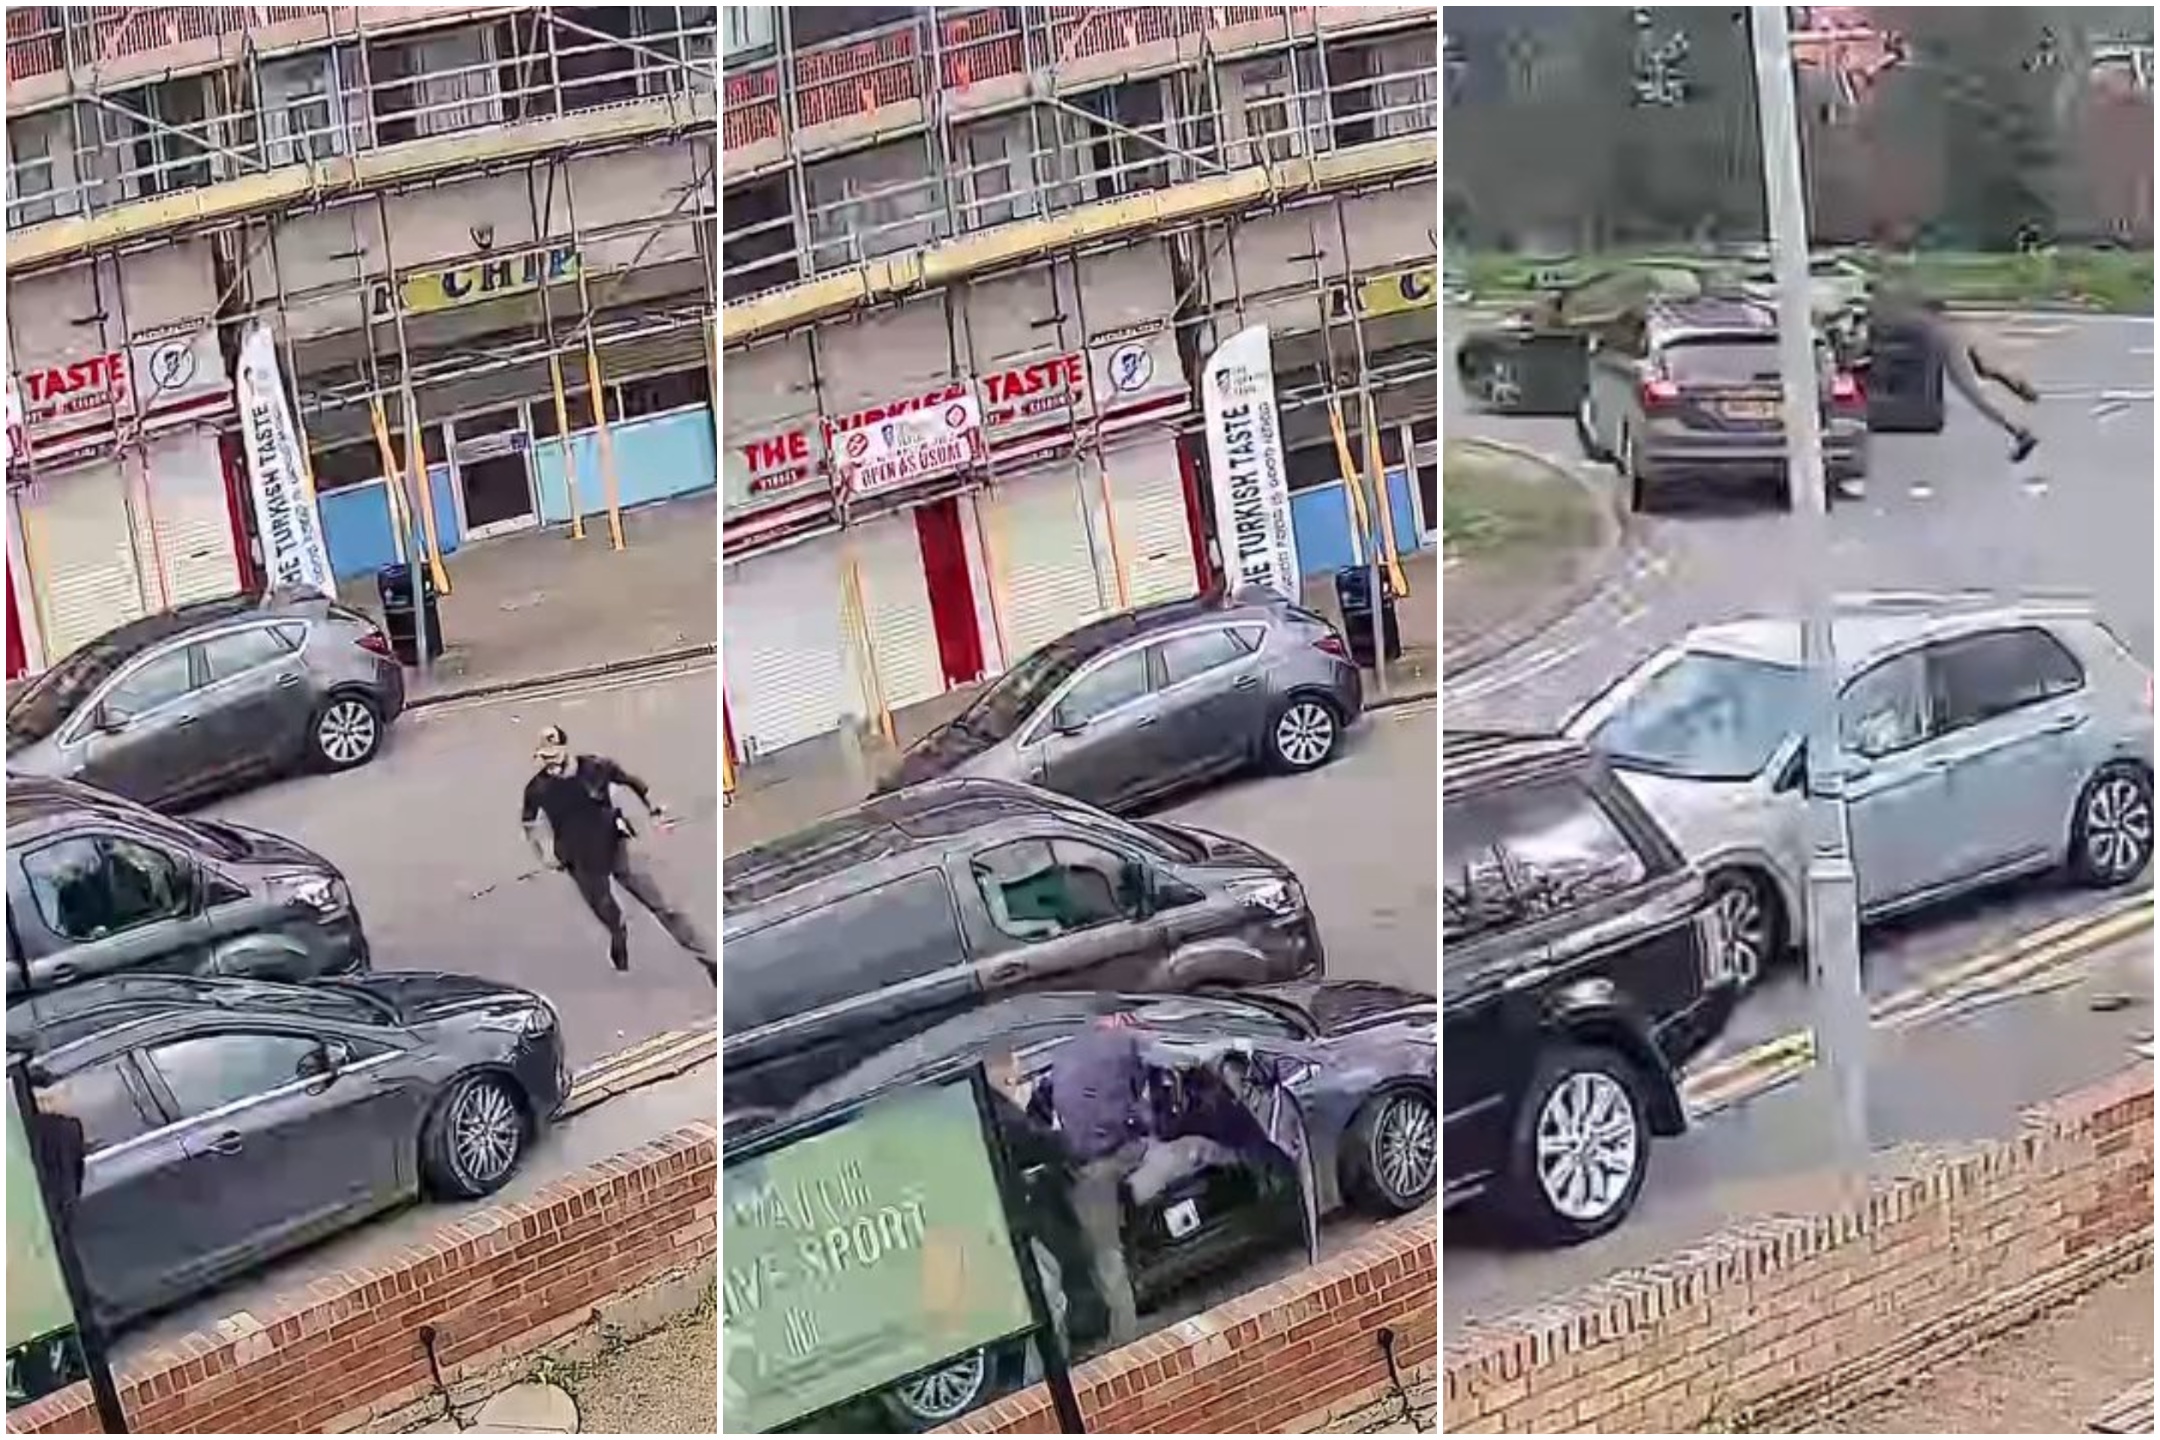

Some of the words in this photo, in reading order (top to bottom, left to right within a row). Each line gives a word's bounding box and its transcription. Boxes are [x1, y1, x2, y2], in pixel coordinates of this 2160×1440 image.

[24, 353, 124, 401] TASTE
[251, 404, 277, 468] TASTE
[743, 430, 809, 472] THE
[984, 354, 1083, 403] TASTE
[1222, 402, 1255, 470] TASTE
[261, 469, 298, 559] TURKISH
[1230, 469, 1268, 562] TURKISH
[278, 556, 302, 585] HE
[1242, 562, 1274, 586] HE
[798, 1200, 927, 1280] SPORT
